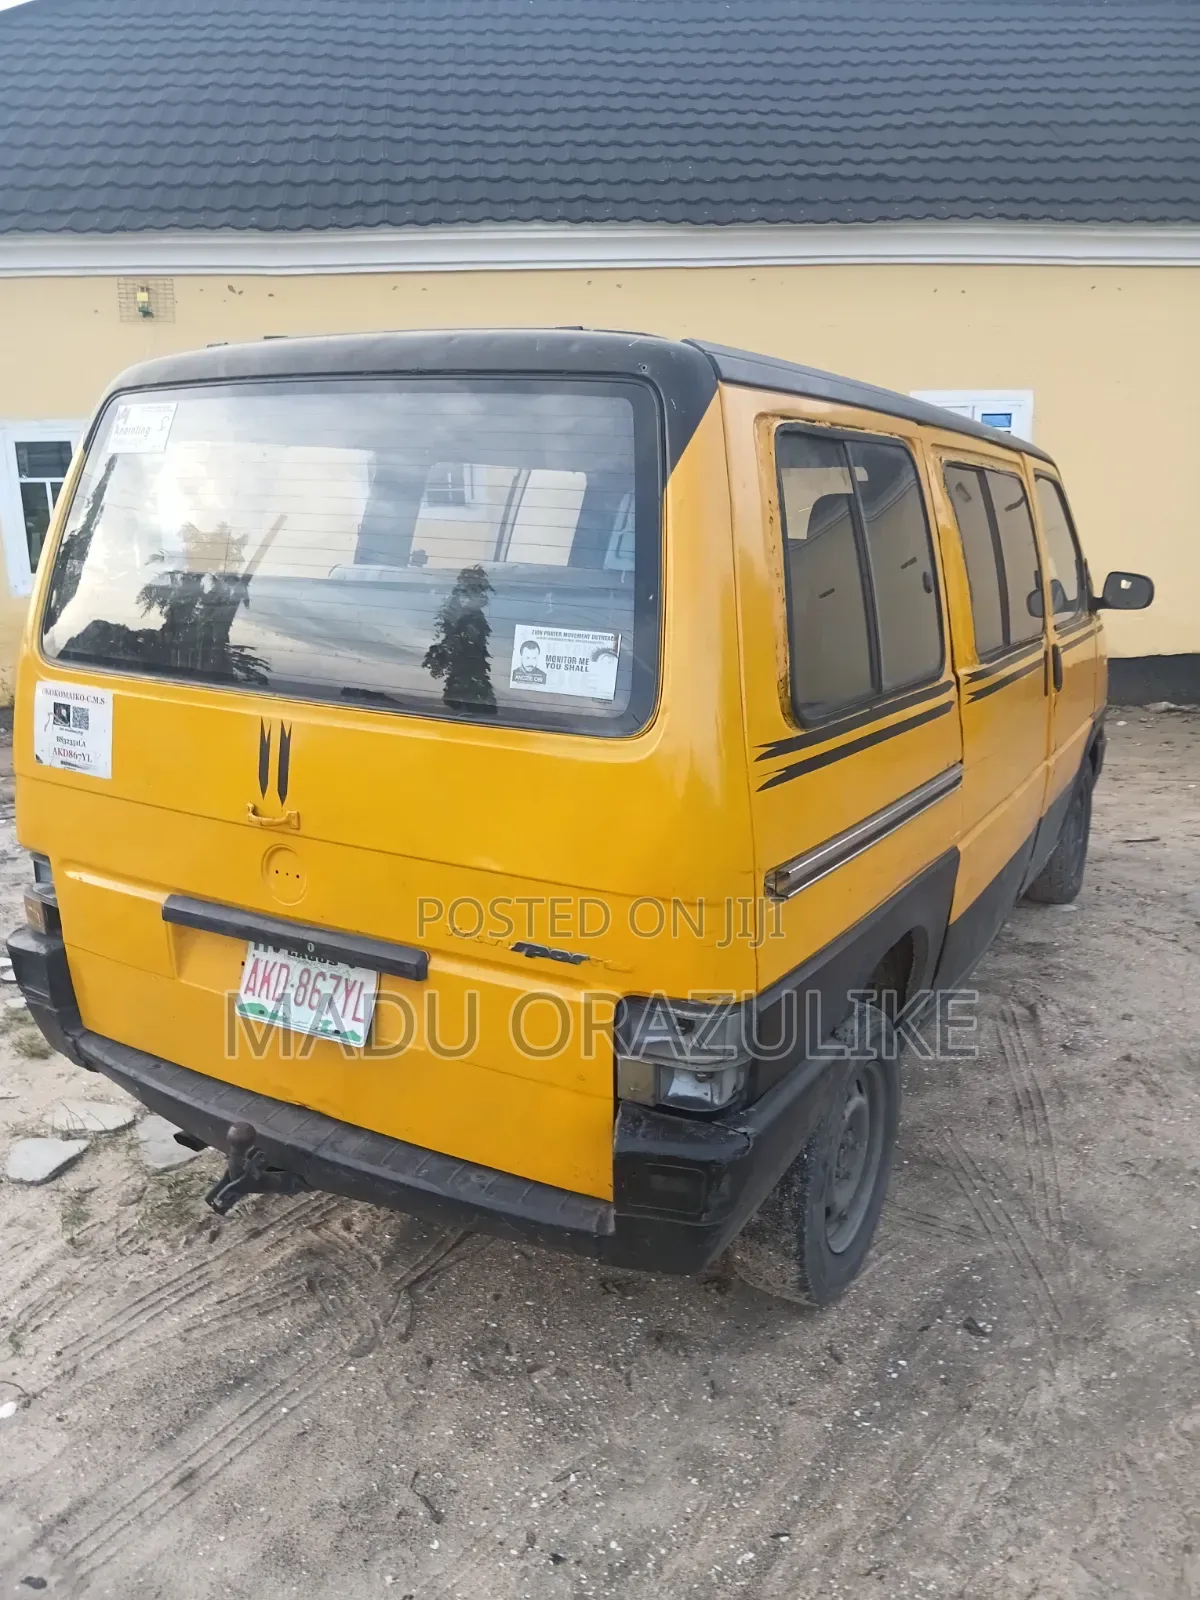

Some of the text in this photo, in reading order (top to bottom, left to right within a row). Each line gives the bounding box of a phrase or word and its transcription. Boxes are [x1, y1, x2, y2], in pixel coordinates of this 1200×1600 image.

[545, 654, 590, 666] MONITOR ME
[545, 662, 590, 673] YOU SHALL
